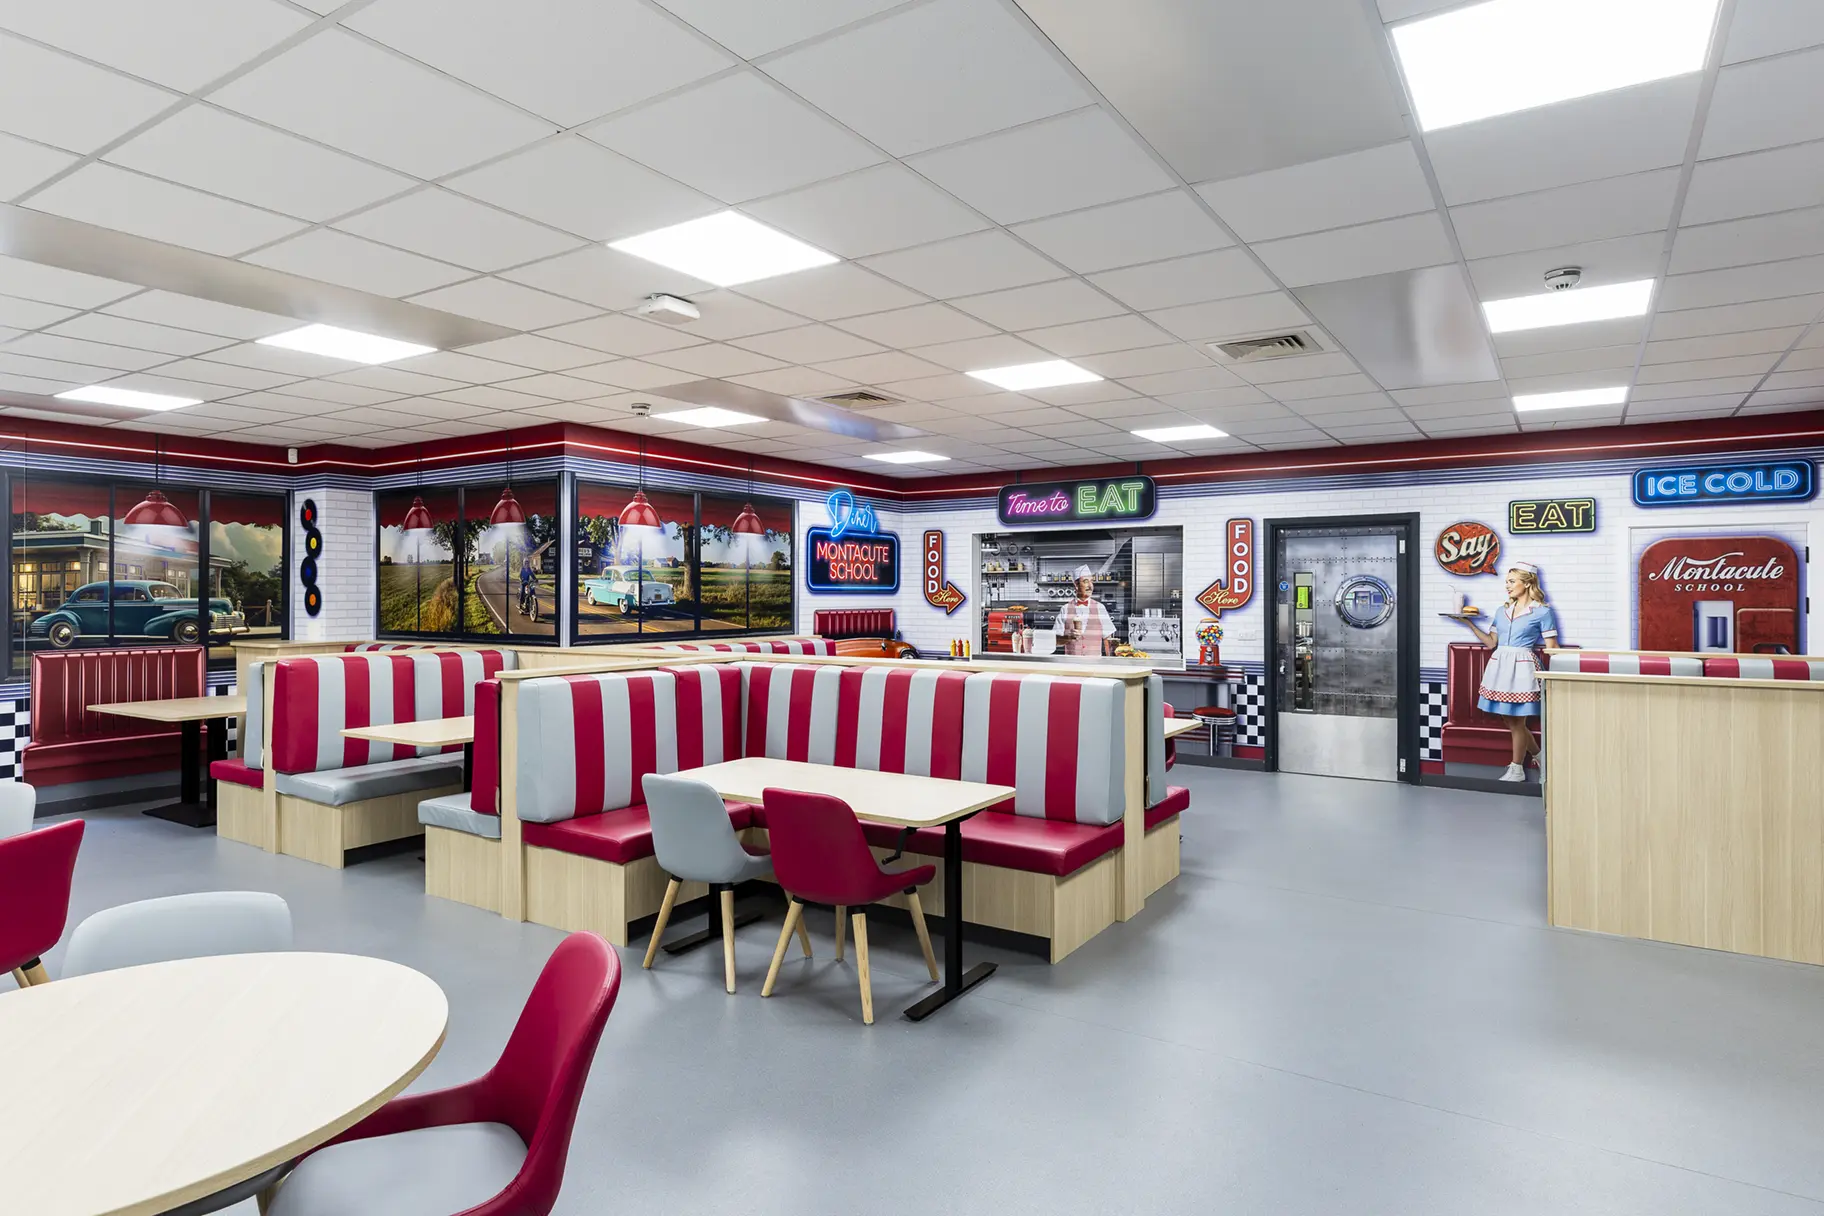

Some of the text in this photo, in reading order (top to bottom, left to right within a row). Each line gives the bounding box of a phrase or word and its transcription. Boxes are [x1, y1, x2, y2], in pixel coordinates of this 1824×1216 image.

[1647, 469, 1799, 496] ICE COLD
[1007, 482, 1144, 515] Time to EAT
[827, 490, 877, 538] Diner
[1513, 501, 1591, 529] EAT
[816, 542, 889, 563] MONTACUTE
[1232, 524, 1249, 594] FOOD
[1439, 531, 1498, 568] Say
[829, 562, 878, 580] SCHOOL
[927, 535, 940, 594] FOOD
[1648, 552, 1784, 581] Montacute
[932, 590, 959, 603] Here
[1203, 591, 1239, 605] Here
[1674, 583, 1746, 592] SCHOOL
